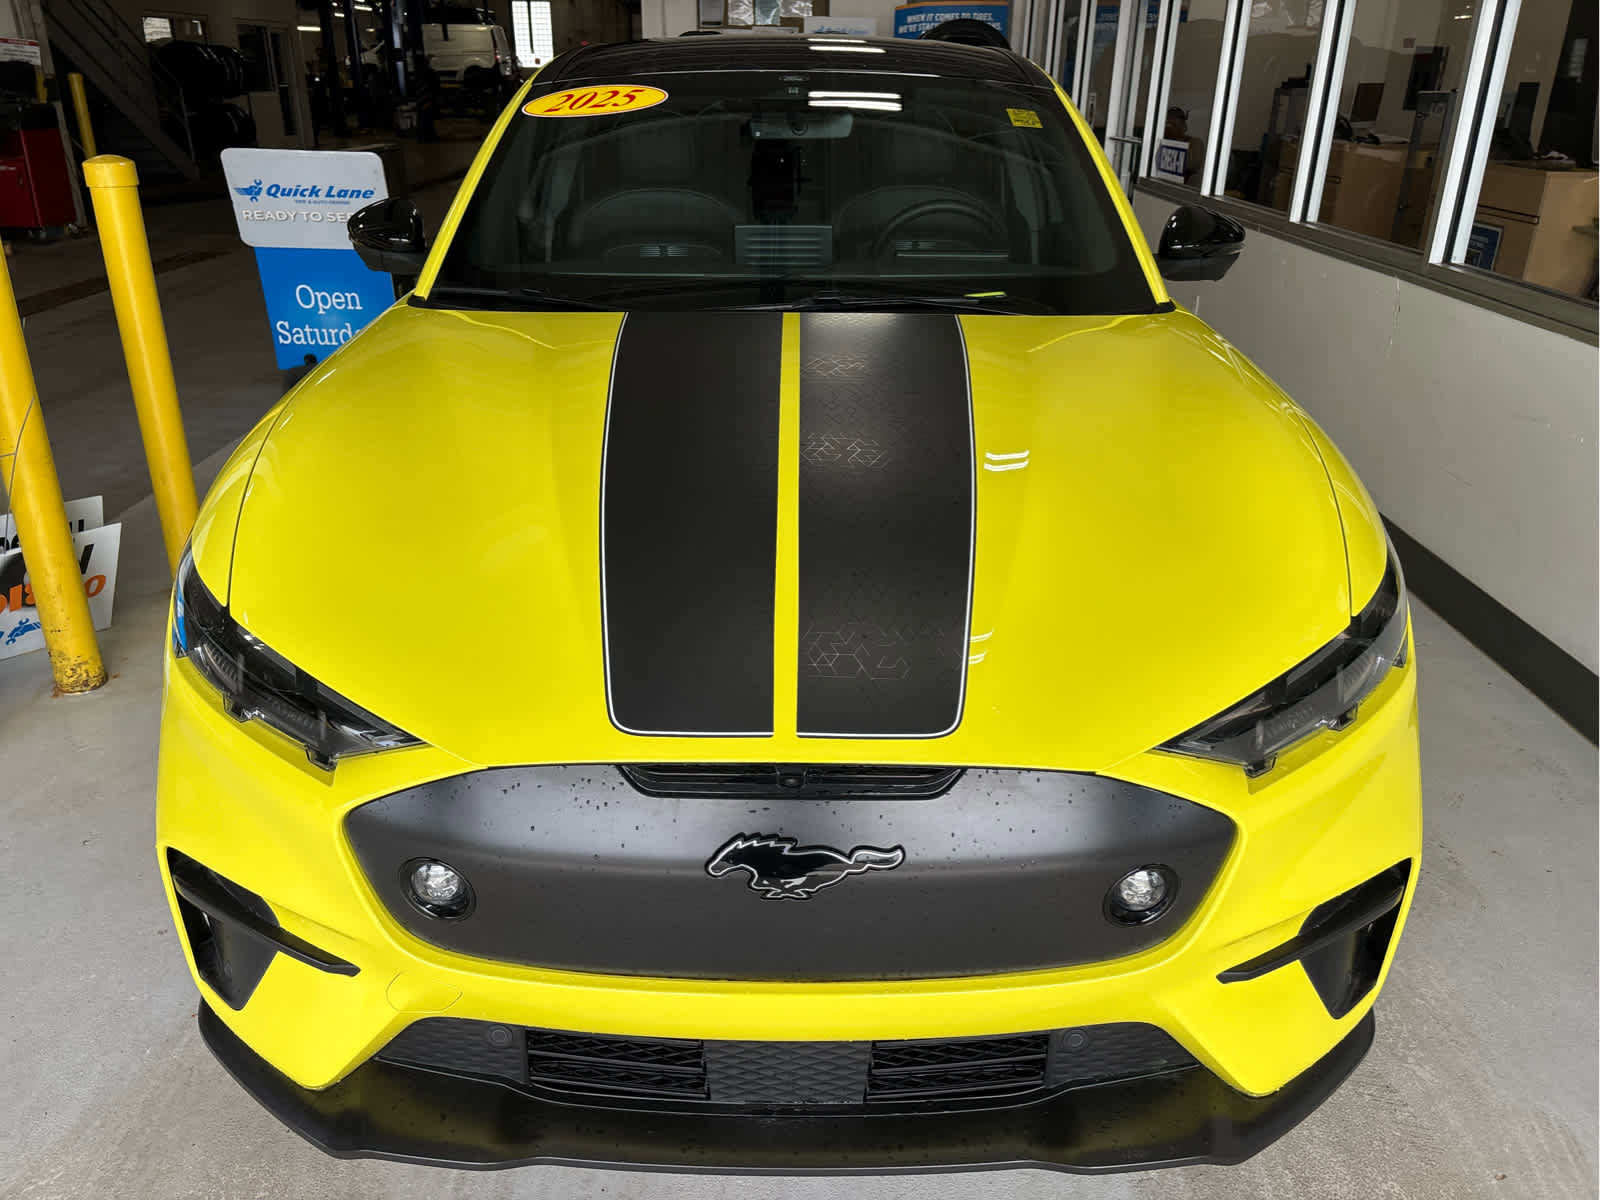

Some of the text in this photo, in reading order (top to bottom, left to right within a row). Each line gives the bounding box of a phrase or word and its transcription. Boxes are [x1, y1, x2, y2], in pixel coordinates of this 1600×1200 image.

[543, 89, 645, 113] 2025
[266, 183, 375, 199] Quick Lane
[242, 209, 297, 221] READY
[303, 210, 323, 222] TO
[295, 284, 363, 314] Open
[276, 320, 361, 346] Saturd
